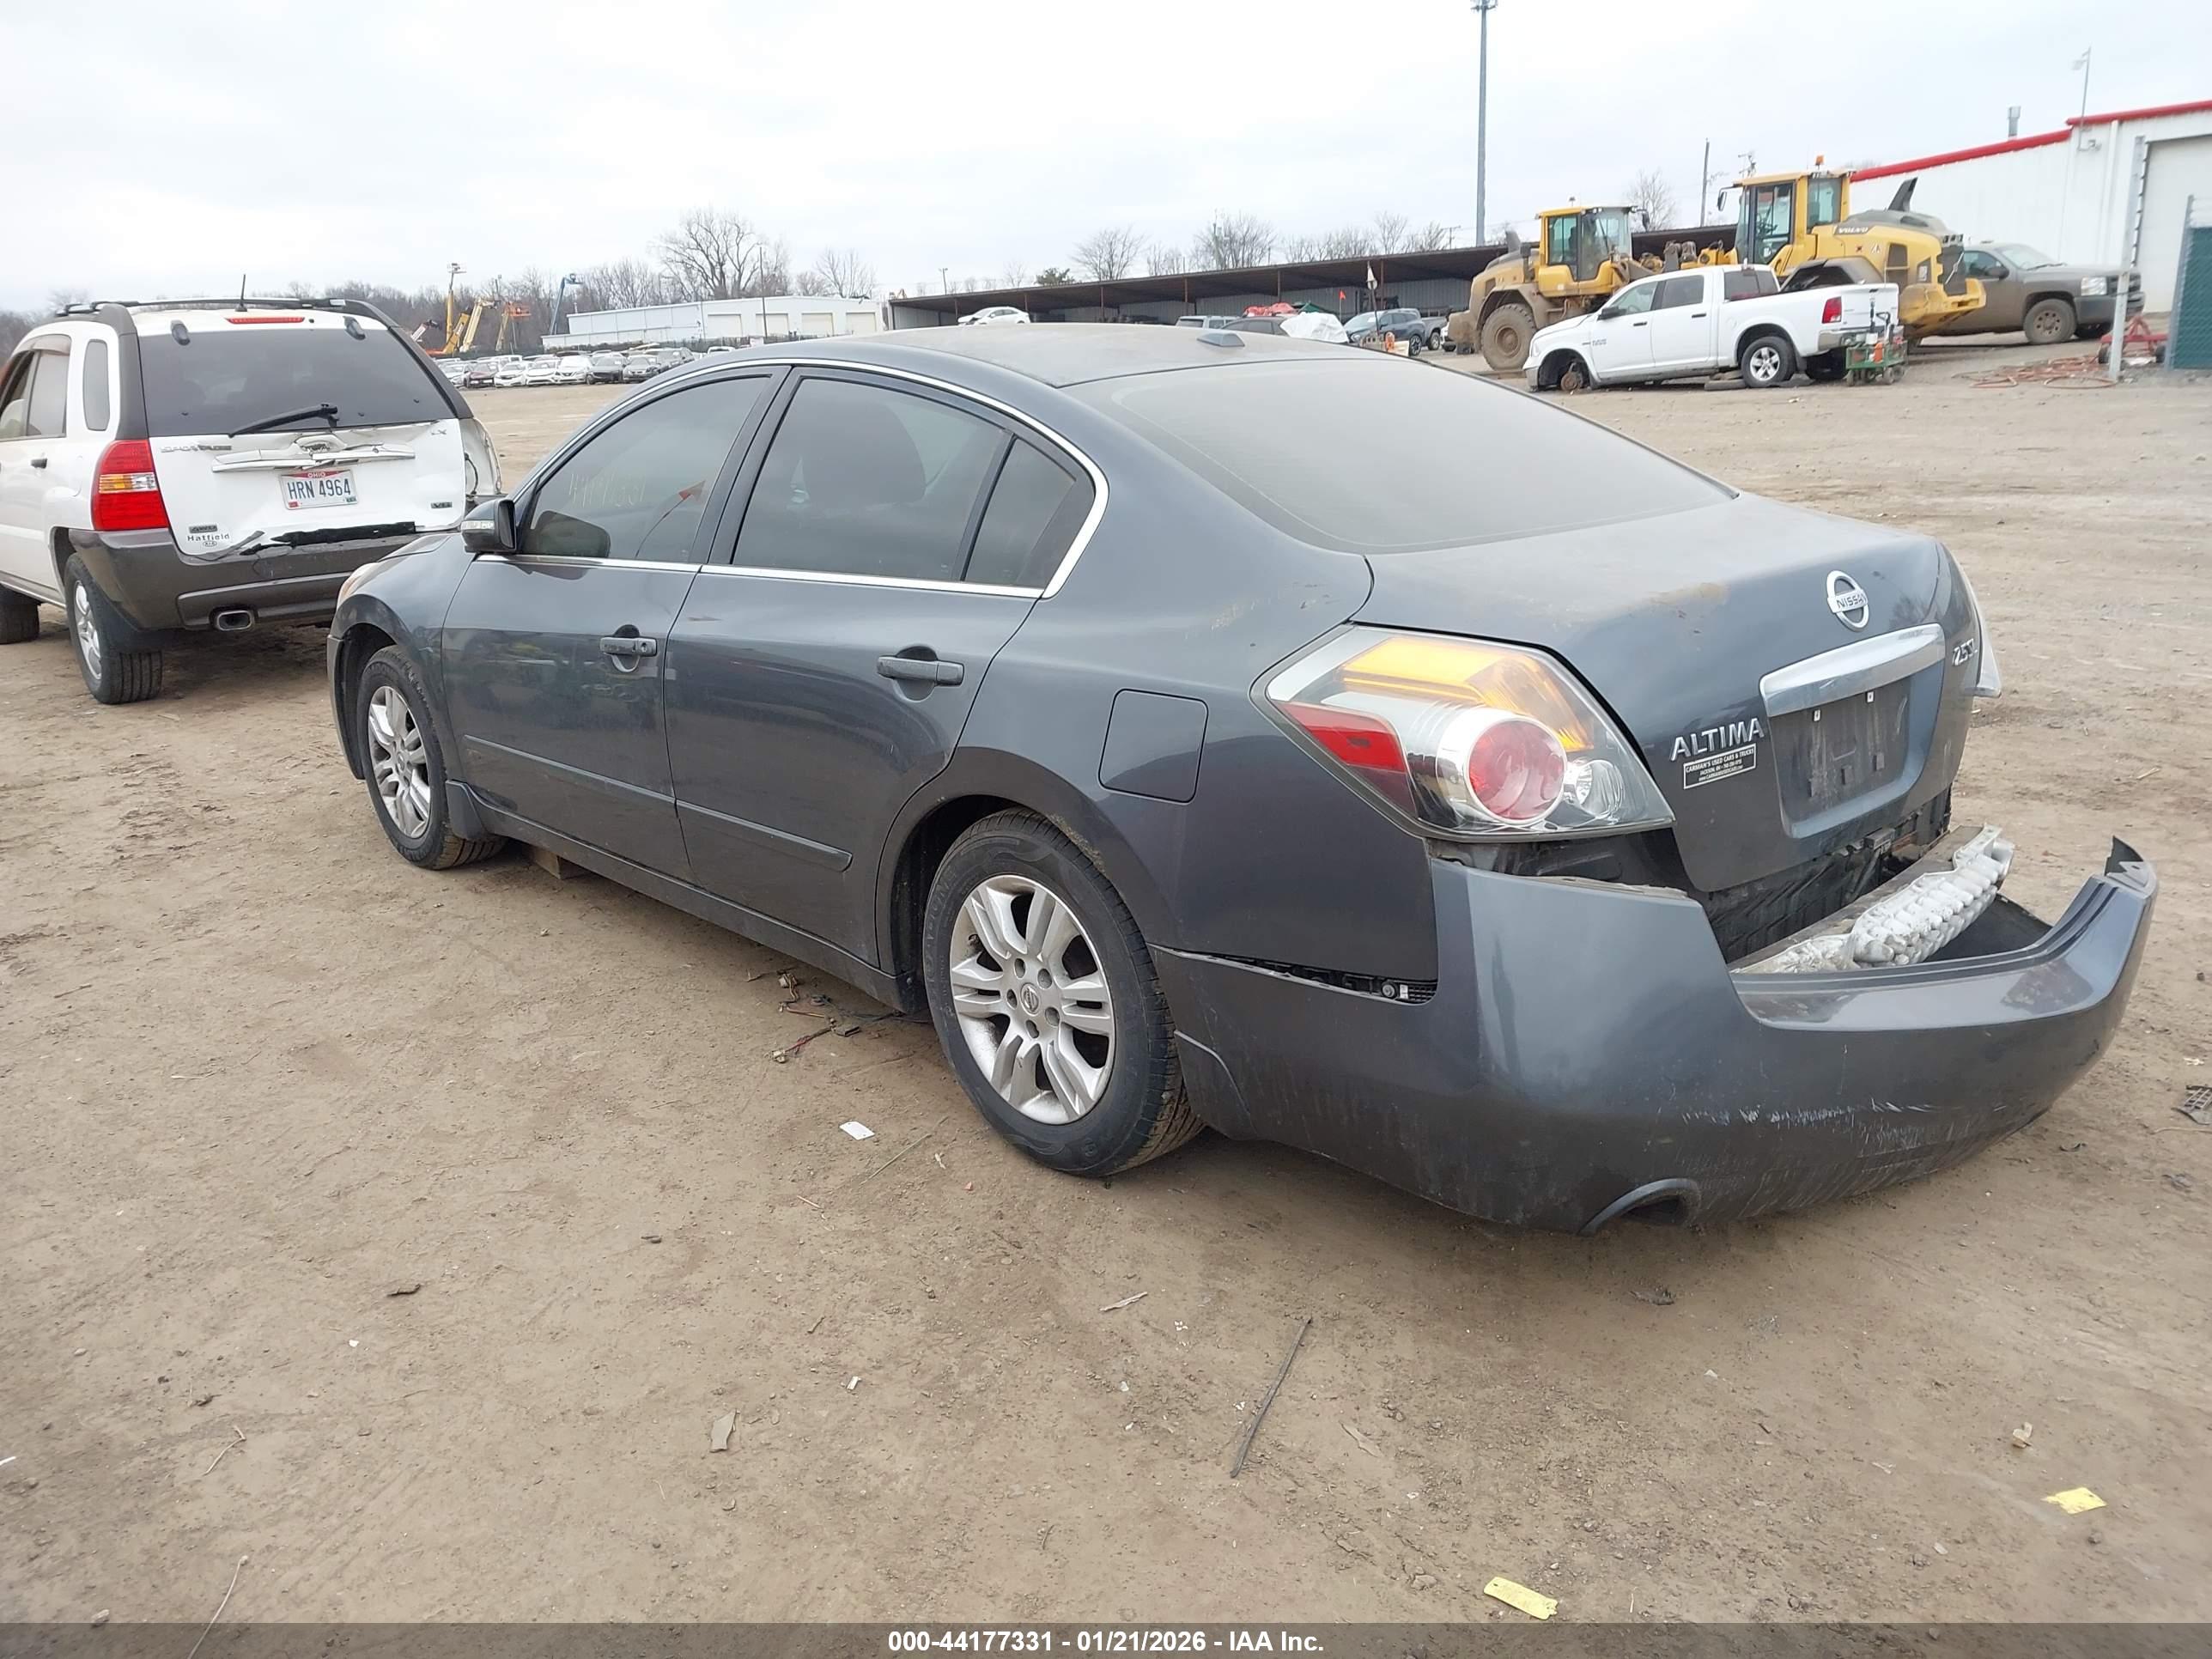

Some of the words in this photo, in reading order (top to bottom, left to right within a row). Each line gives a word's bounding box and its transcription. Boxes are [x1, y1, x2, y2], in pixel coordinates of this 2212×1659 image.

[287, 480, 316, 500] HRN
[319, 477, 351, 497] 4964
[186, 533, 230, 542] Hatfield
[1670, 717, 1765, 761] ALTIMA
[1711, 757, 1723, 766] USED
[1723, 752, 1735, 763] CARS
[1739, 748, 1754, 757] TRUCKS
